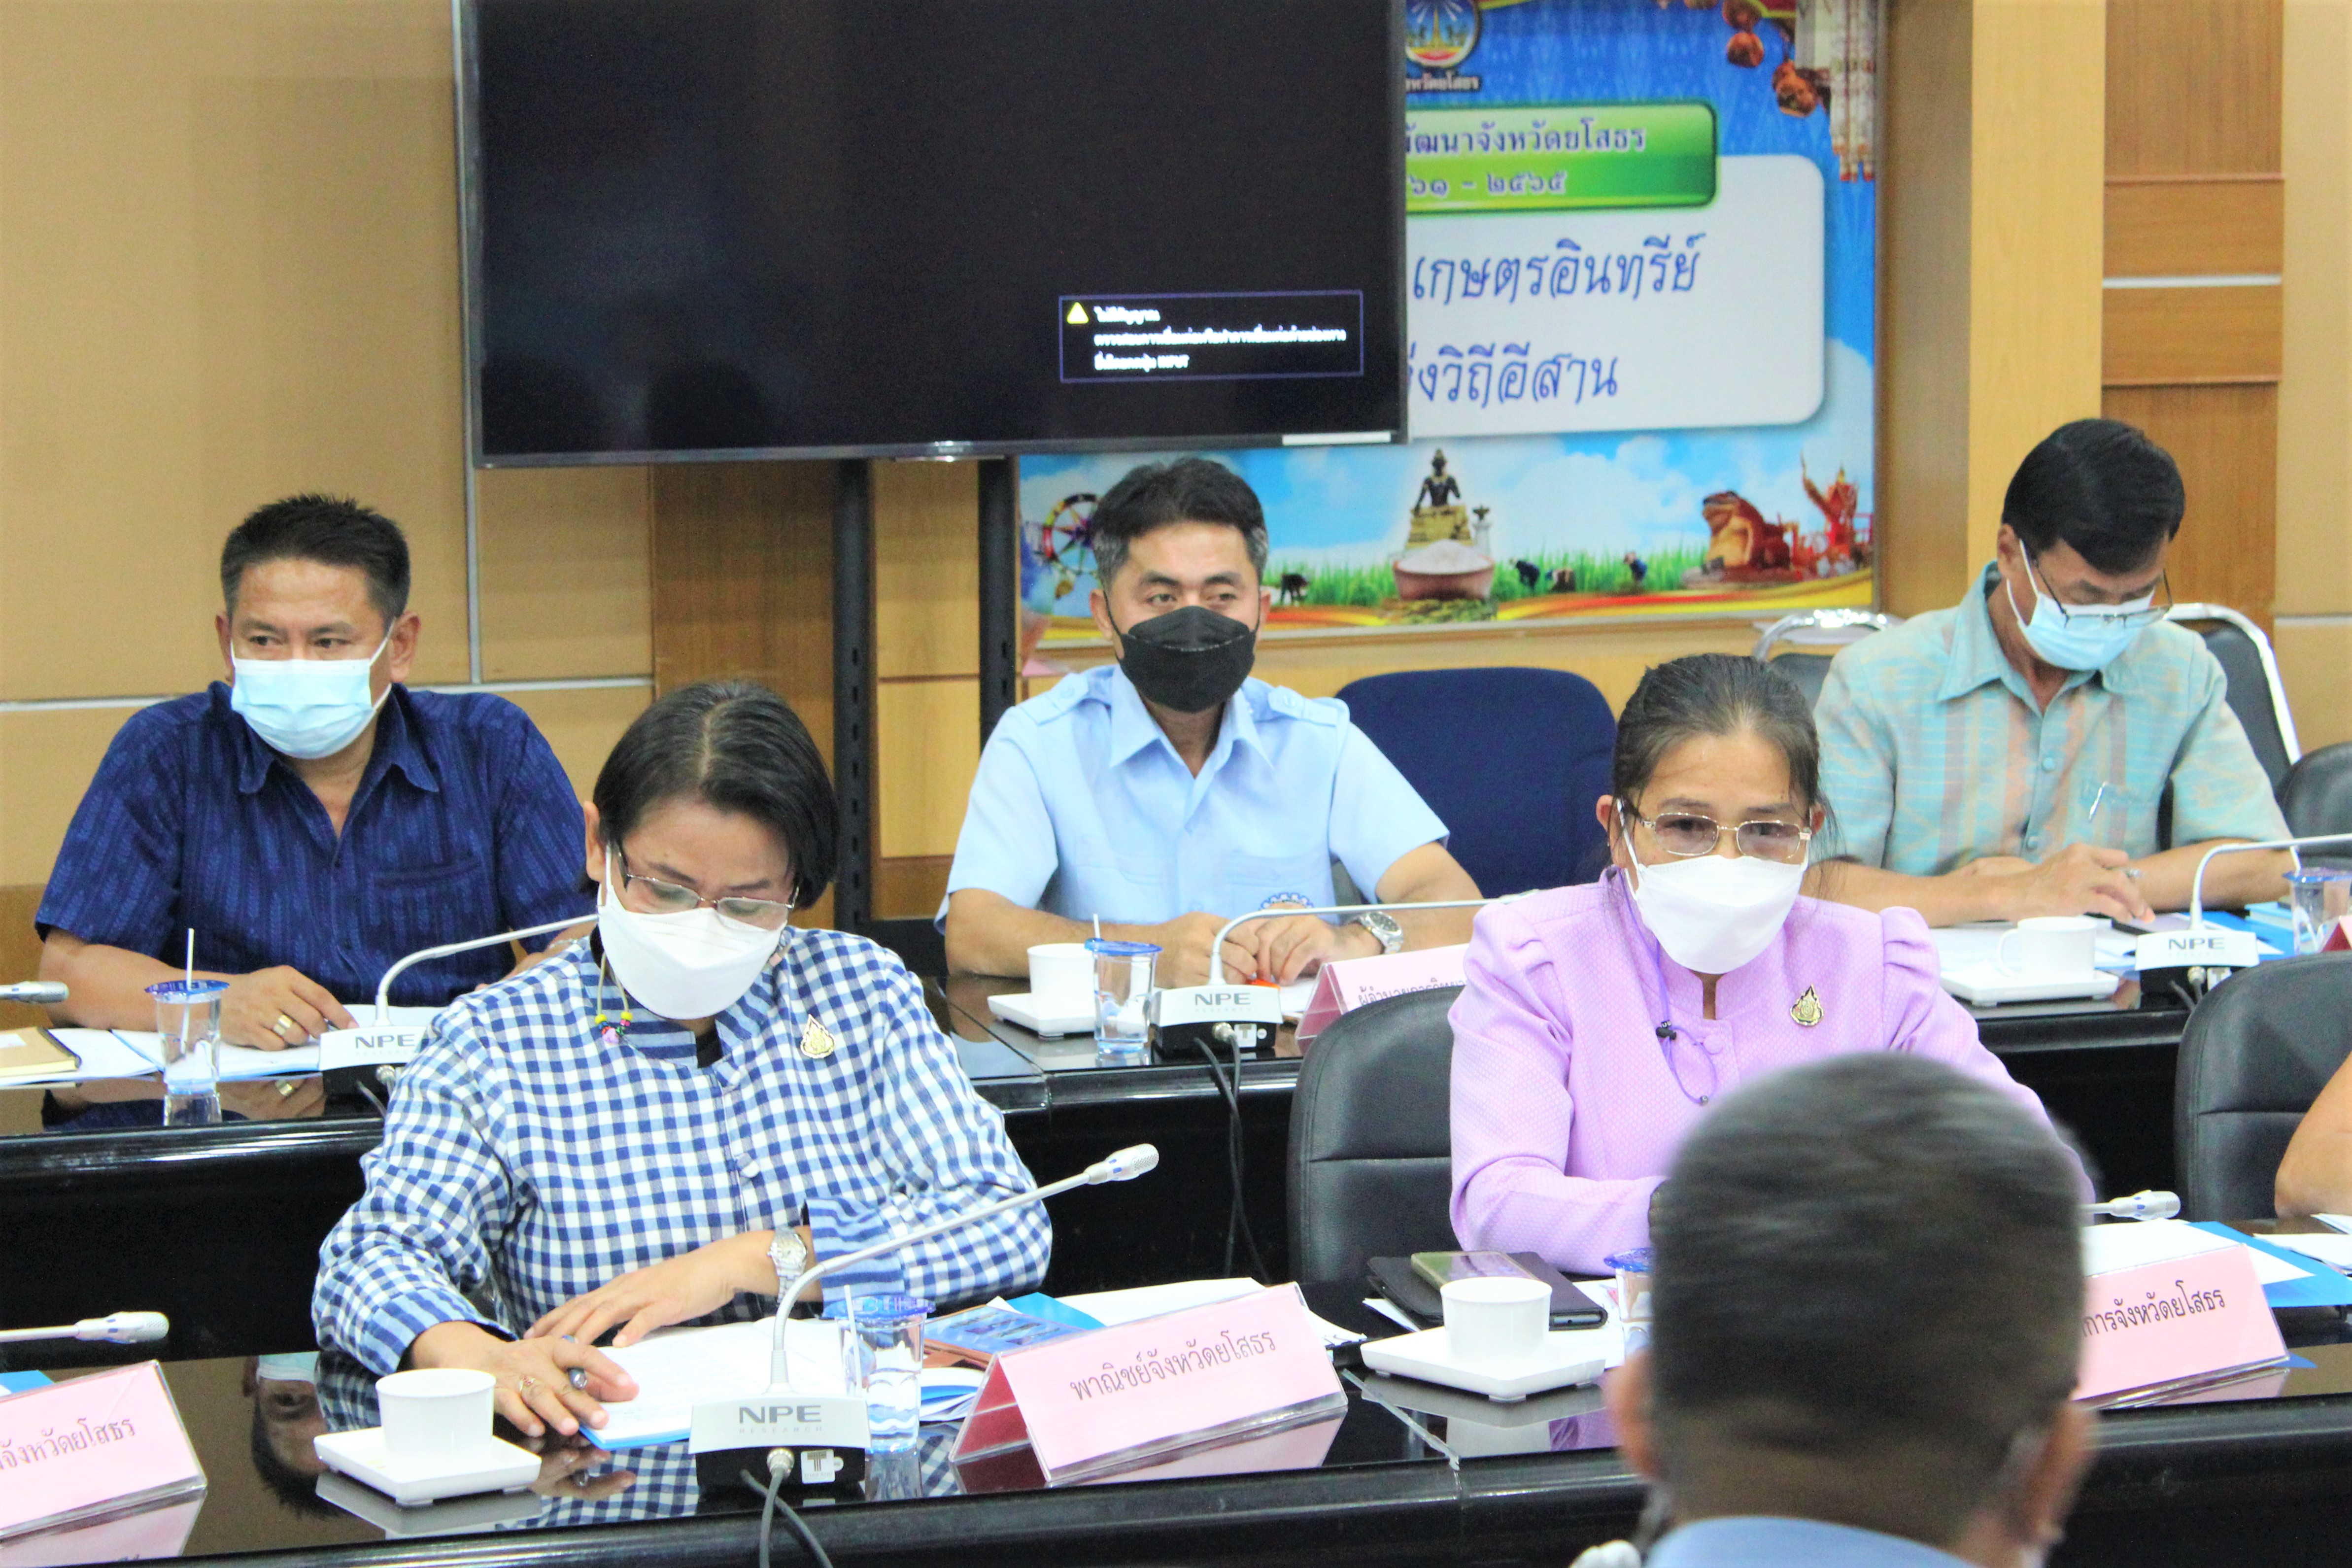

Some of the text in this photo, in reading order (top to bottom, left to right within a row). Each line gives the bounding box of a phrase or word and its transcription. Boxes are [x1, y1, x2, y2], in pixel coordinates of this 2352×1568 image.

[1406, 117, 1645, 155] ัฒนาจังหวัดยโสธร
[1413, 232, 1706, 306] เกษตรอินทรีย์
[1407, 341, 1620, 409] ่งวิถีอีสาน
[2168, 937, 2225, 950] NPE
[1194, 992, 1251, 1006] NPE
[355, 1034, 416, 1049] NPE
[2081, 1279, 2226, 1336] การจังหวัดยโสธร
[1069, 1329, 1277, 1400] พาณิชย์จังหวัดยโสธร
[739, 1405, 821, 1424] NPE
[0, 1417, 136, 1470] จังหวัดยโสธร
